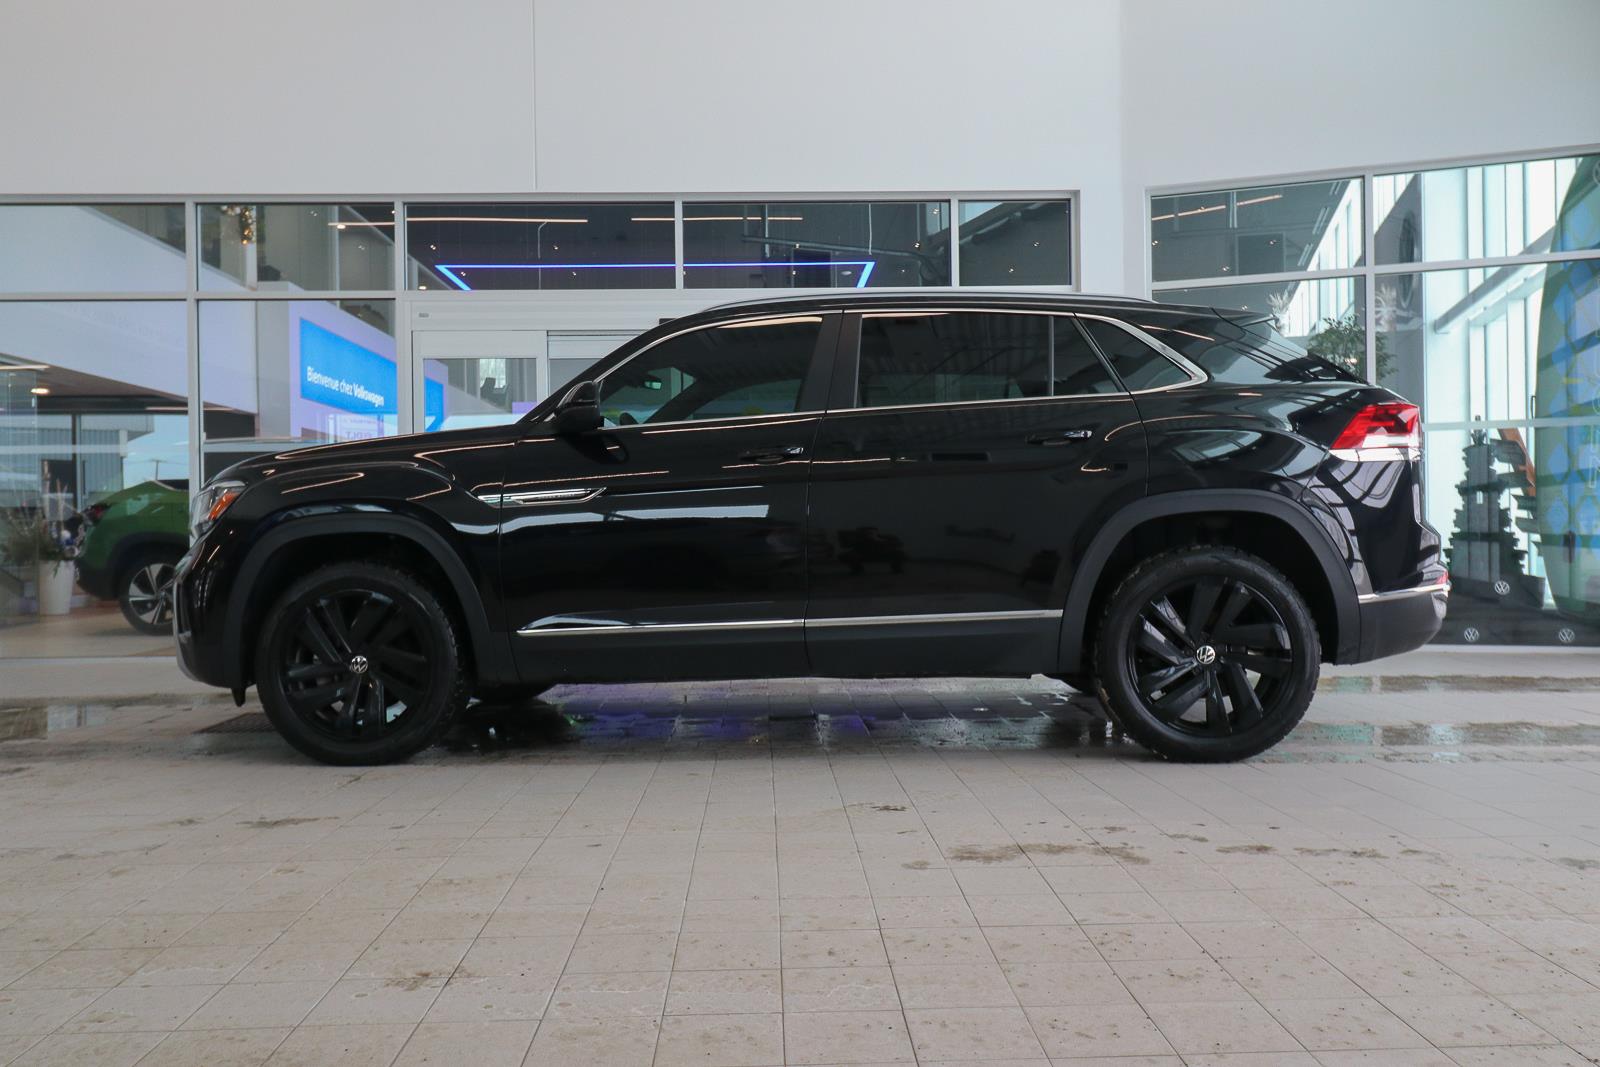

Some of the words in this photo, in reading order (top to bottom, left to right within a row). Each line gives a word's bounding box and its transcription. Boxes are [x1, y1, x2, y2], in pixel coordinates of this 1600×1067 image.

[306, 366, 339, 392] Bienvenue
[339, 378, 353, 396] chez
[353, 383, 385, 407] Volkswagen
